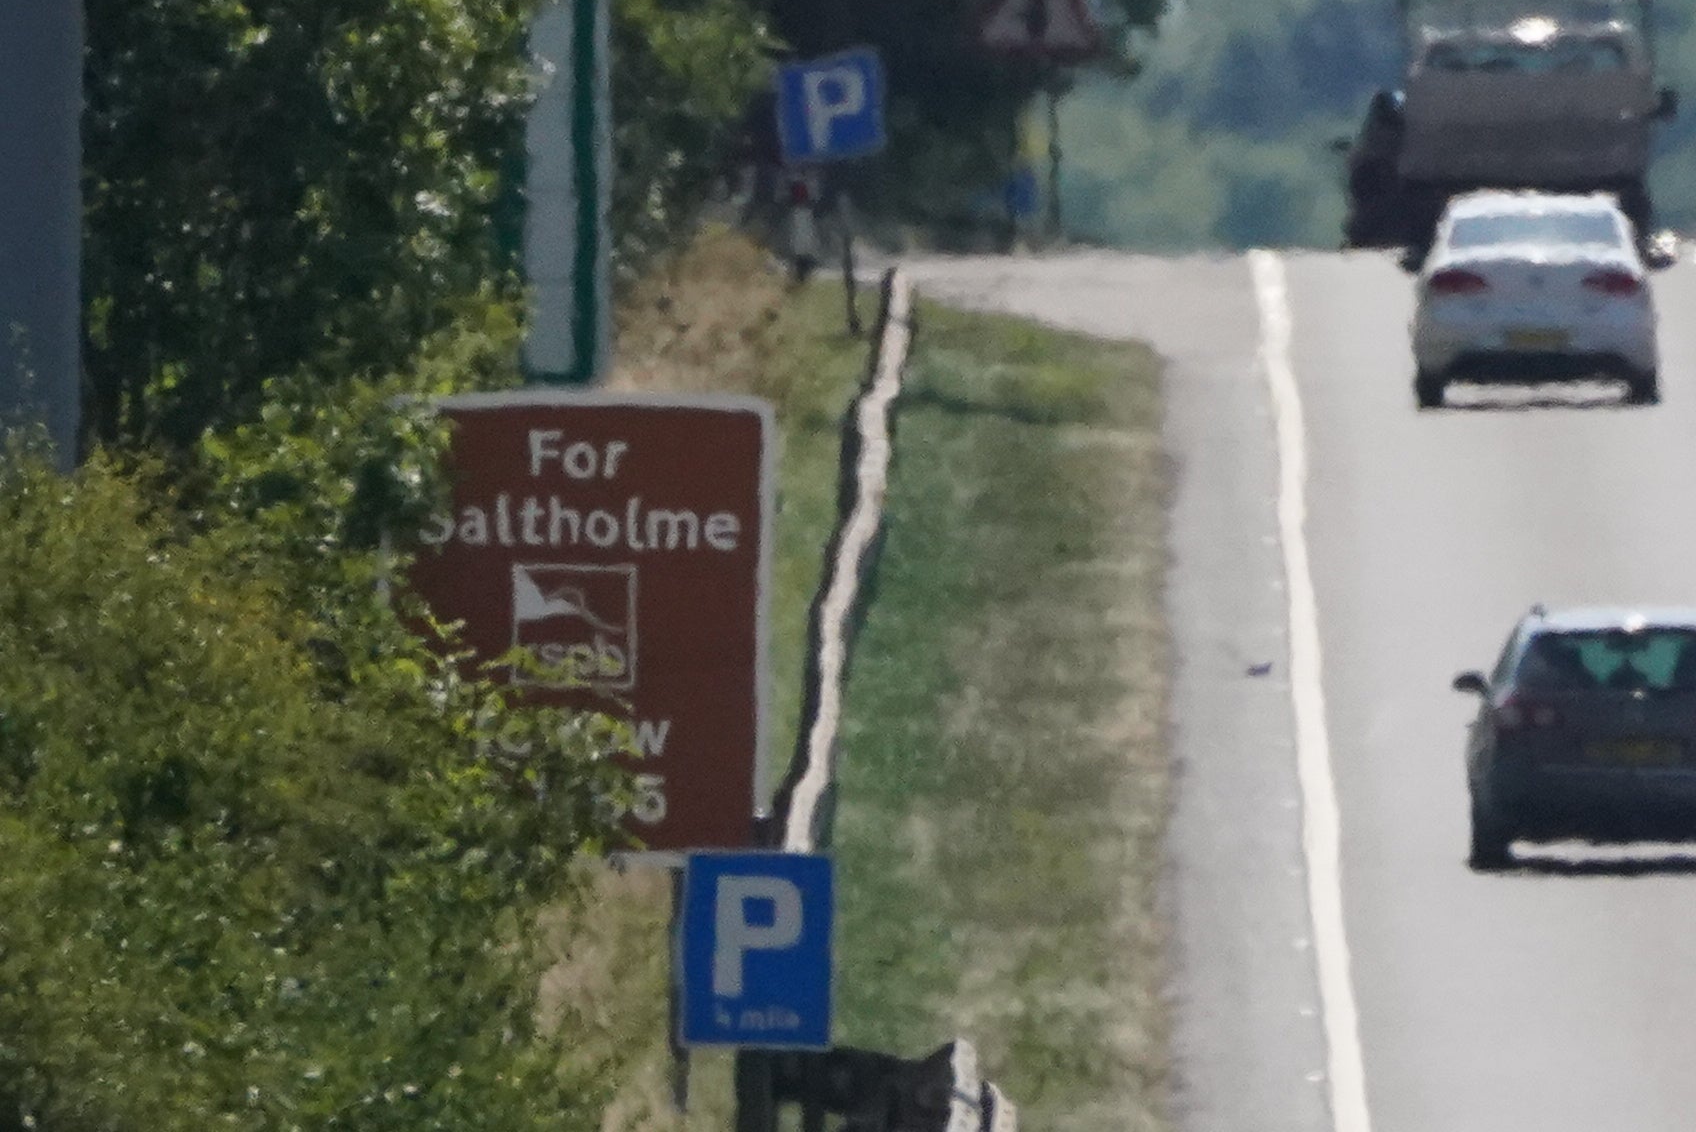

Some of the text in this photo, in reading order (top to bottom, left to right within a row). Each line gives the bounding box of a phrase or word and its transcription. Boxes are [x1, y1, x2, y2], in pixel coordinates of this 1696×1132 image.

[804, 69, 866, 151] P
[528, 429, 628, 479] For
[714, 875, 803, 998] P
